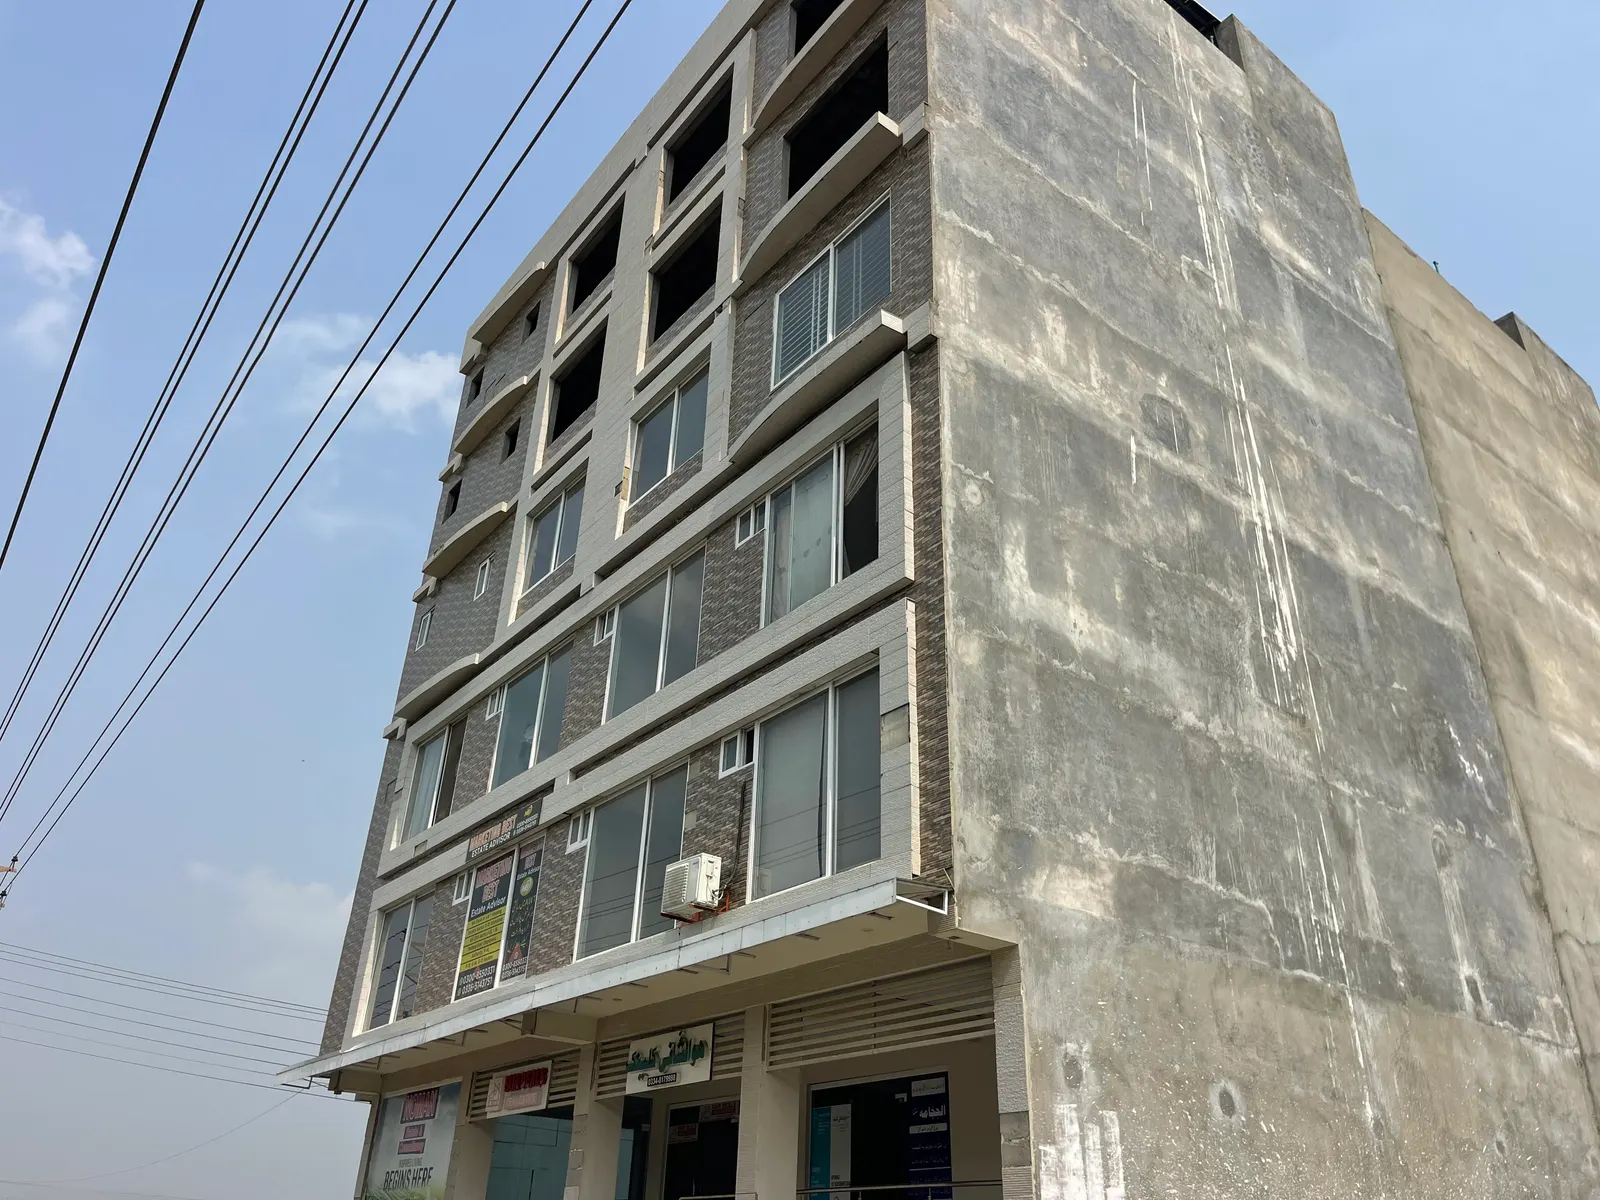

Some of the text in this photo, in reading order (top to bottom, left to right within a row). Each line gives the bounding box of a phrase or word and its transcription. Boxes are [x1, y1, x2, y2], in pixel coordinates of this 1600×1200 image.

[471, 831, 511, 858] ESTATE ADVISOR
[475, 855, 513, 889] MARKETING
[482, 880, 500, 903] BEST
[470, 903, 486, 918] Estate
[485, 896, 507, 912] Advisor
[383, 1166, 434, 1191] BEGINS HERE
